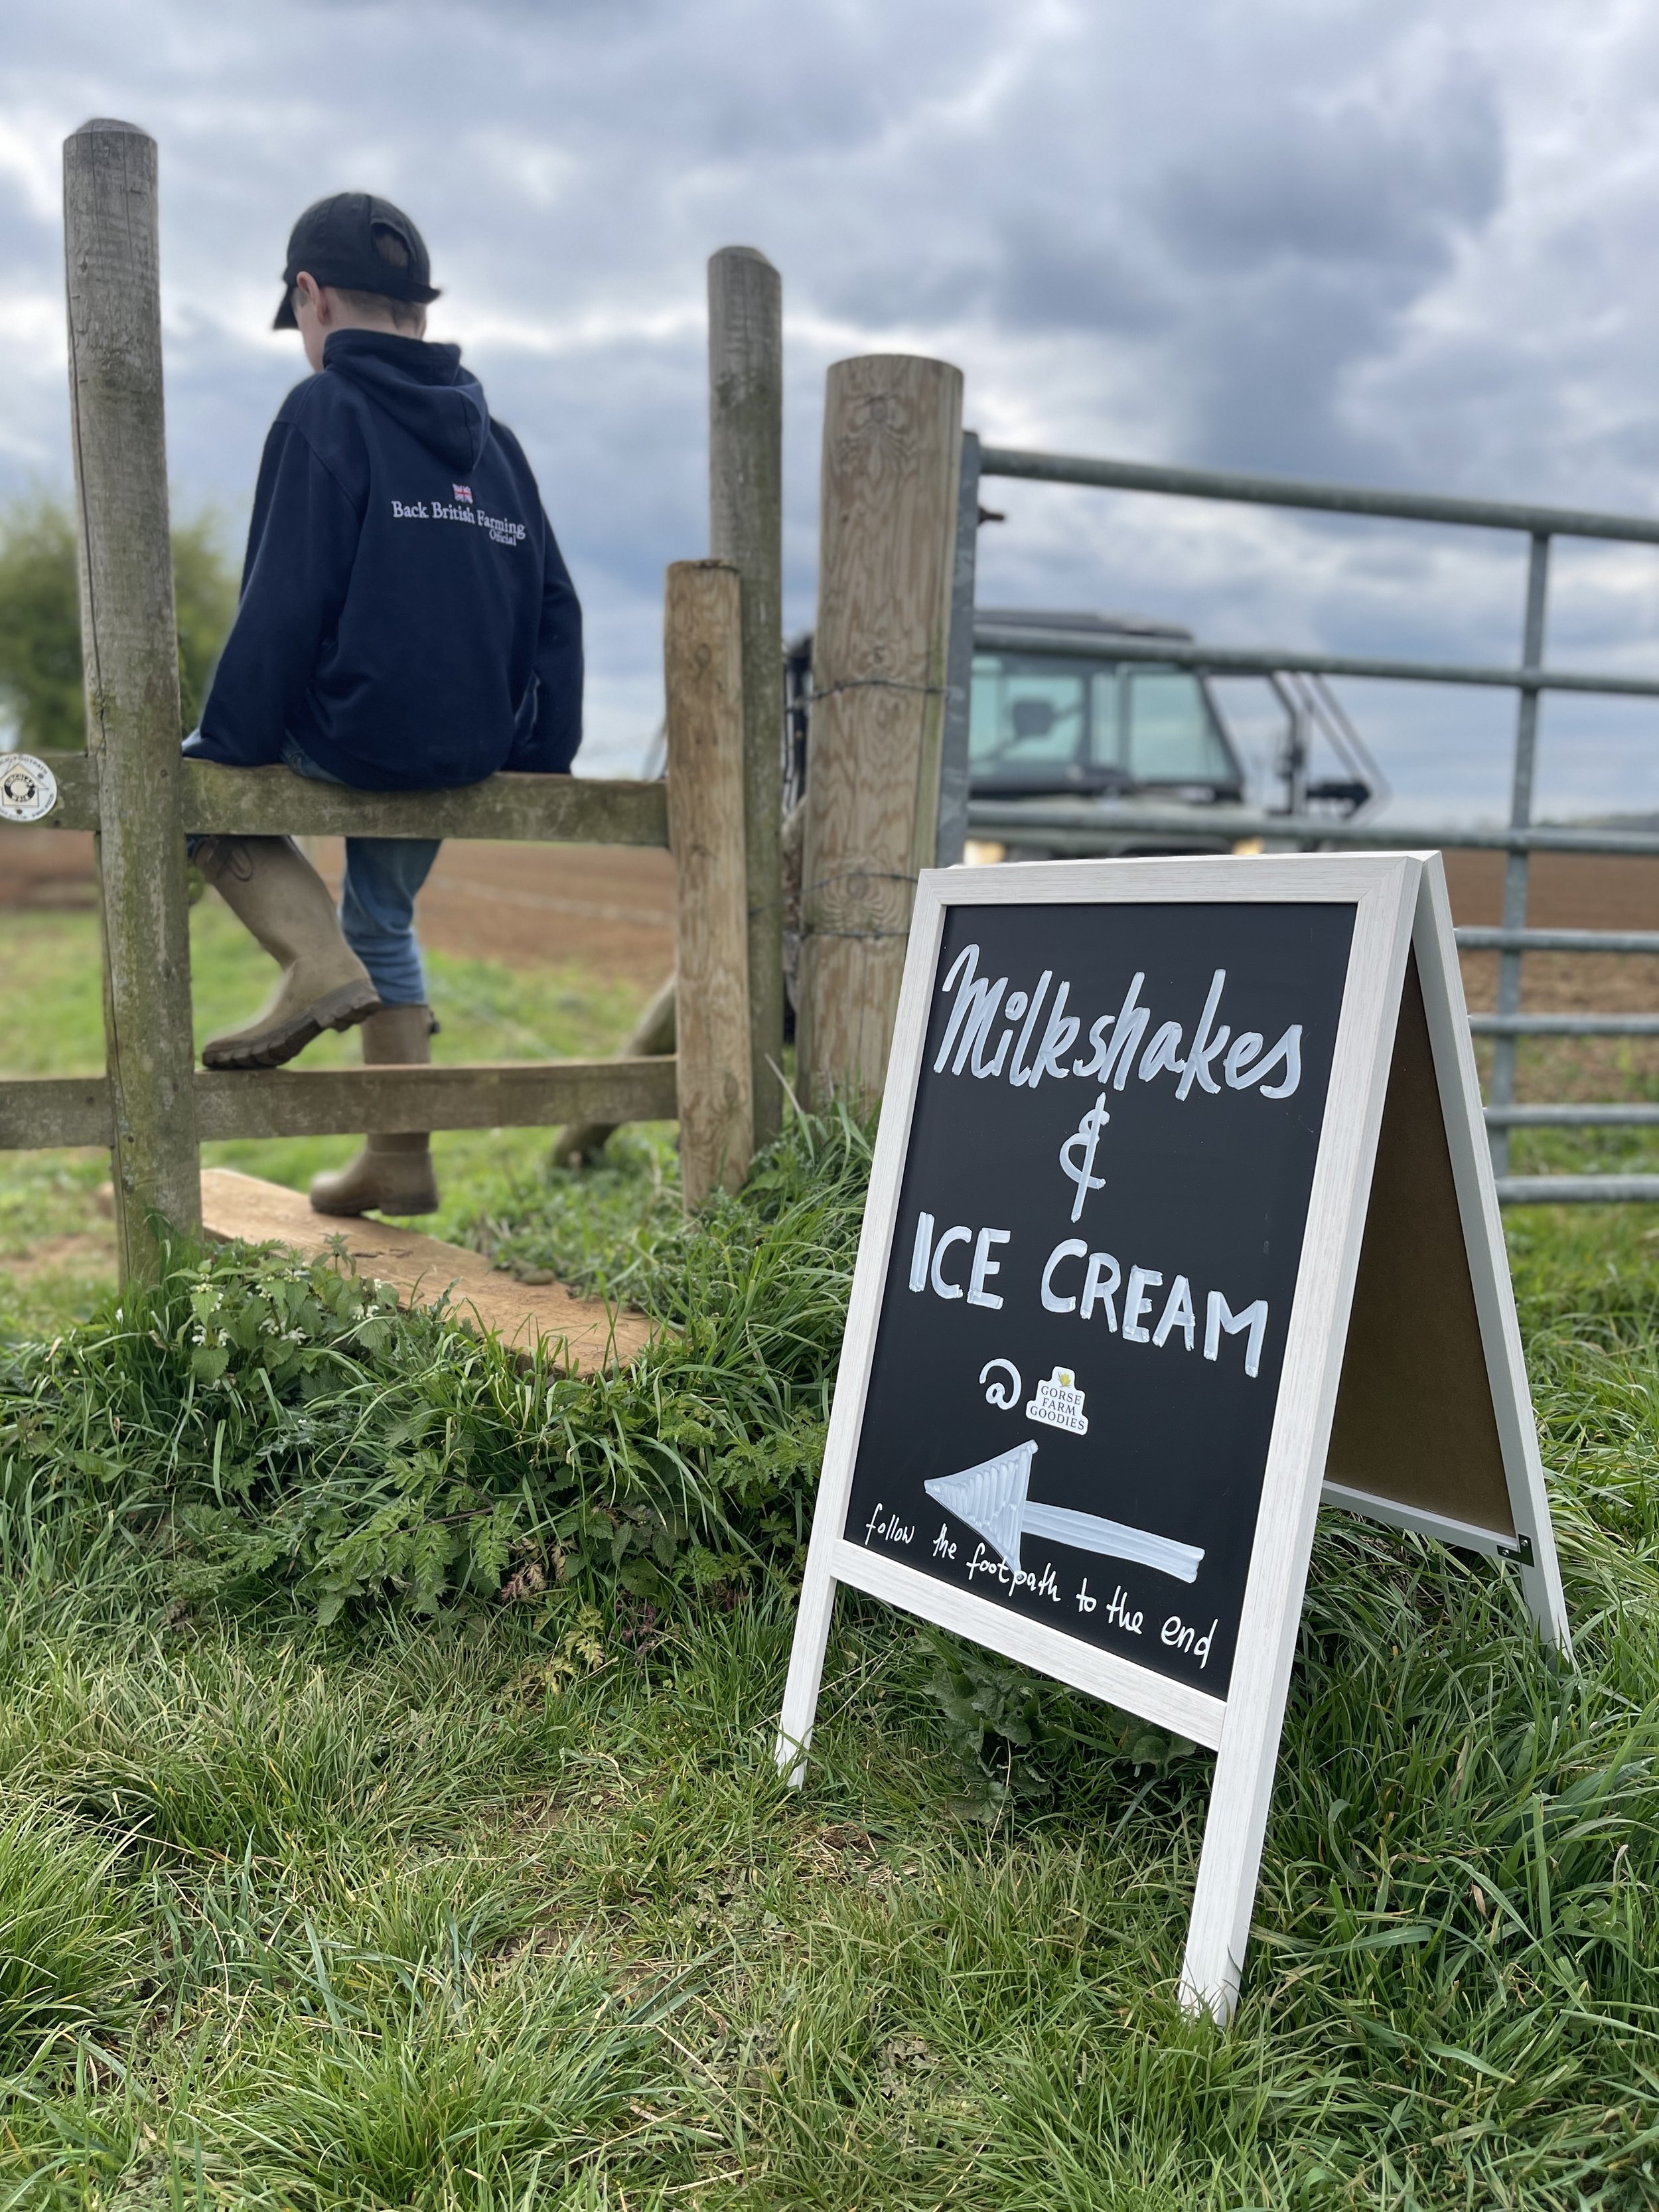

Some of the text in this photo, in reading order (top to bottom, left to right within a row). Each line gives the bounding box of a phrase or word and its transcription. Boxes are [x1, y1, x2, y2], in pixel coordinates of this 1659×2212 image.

[392, 501, 526, 540] Back British Farming
[489, 529, 516, 546] Official
[934, 944, 1302, 1101] Milkshakes
[1060, 1092, 1110, 1223] &
[909, 1211, 1269, 1378] ICE CREAM
[979, 1359, 1021, 1410] @
[1041, 1385, 1082, 1405] GORSE
[1042, 1397, 1076, 1416] FARM
[1030, 1406, 1085, 1430] GOODIES
[865, 1503, 914, 1544] follow
[933, 1523, 957, 1560] the
[1076, 1577, 1097, 1613] to
[1106, 1585, 1143, 1635] the
[1161, 1615, 1218, 1669] end
